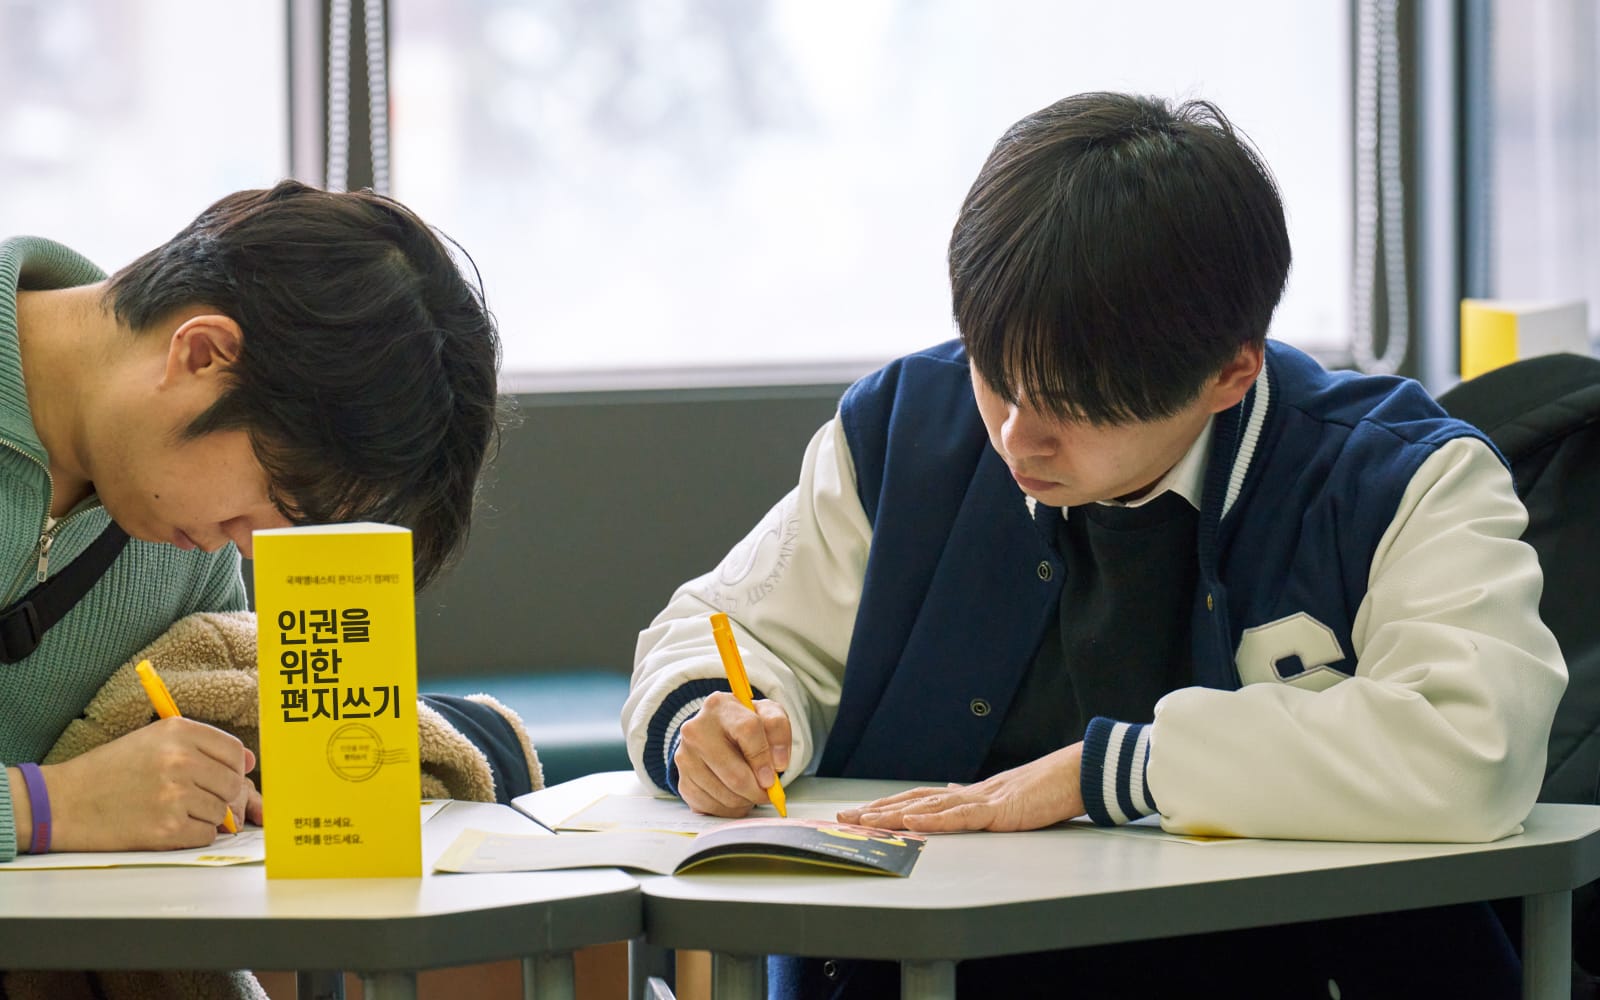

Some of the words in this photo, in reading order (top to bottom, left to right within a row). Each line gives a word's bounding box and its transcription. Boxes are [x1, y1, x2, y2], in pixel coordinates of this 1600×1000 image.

[338, 574, 372, 585] 편지쓰기
[277, 608, 370, 645] 인권을
[279, 648, 342, 684] 위한
[280, 685, 400, 722] 편지쓰기
[293, 817, 321, 829] 편지를
[323, 817, 354, 828] 쓰세요.
[293, 833, 321, 846] 변화를
[322, 833, 363, 845] 만드세요.
